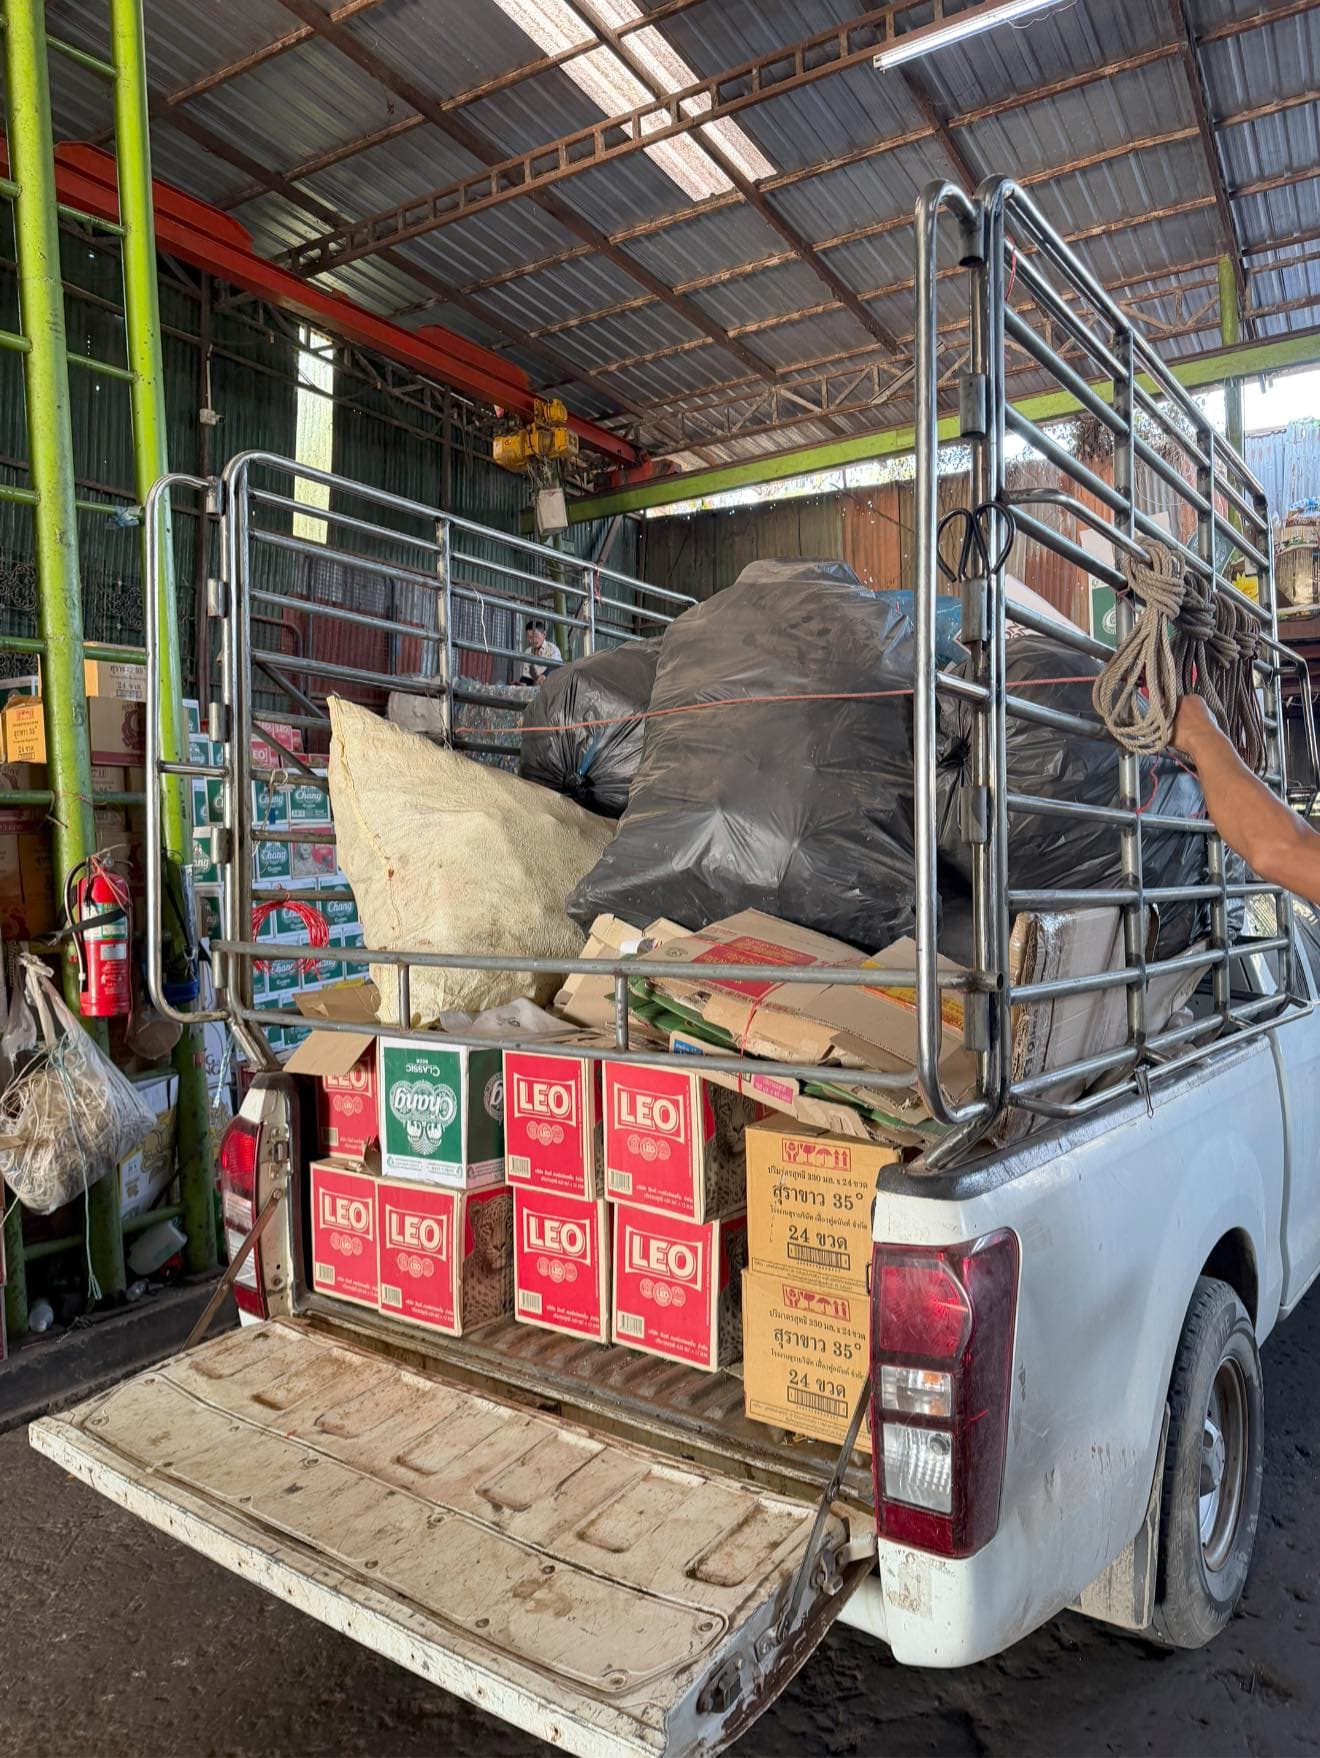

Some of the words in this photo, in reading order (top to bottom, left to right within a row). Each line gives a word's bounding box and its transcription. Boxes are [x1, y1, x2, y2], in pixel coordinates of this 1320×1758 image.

[252, 750, 266, 760] EO
[295, 790, 321, 801] Chang
[262, 849, 286, 863] Chang
[327, 901, 353, 914] Chang
[406, 1063, 440, 1077] CLASSIC
[394, 1087, 454, 1121] Chang
[519, 1080, 571, 1118] LEO
[620, 1091, 679, 1134] LEO
[773, 1184, 825, 1207] สุราขาว
[833, 1192, 863, 1210] 35°
[843, 1179, 852, 1187] 24
[324, 1194, 369, 1233] LEO
[390, 1212, 442, 1253] LEO
[529, 1215, 585, 1257] LEO
[788, 1224, 809, 1243] 24
[816, 1232, 847, 1251] ขวด
[632, 1234, 696, 1281] LEO
[774, 1328, 826, 1353] สุราขาว
[833, 1340, 862, 1360] 35°
[842, 1328, 851, 1337] 24
[789, 1369, 809, 1388] 24
[816, 1378, 846, 1398] ขวด
